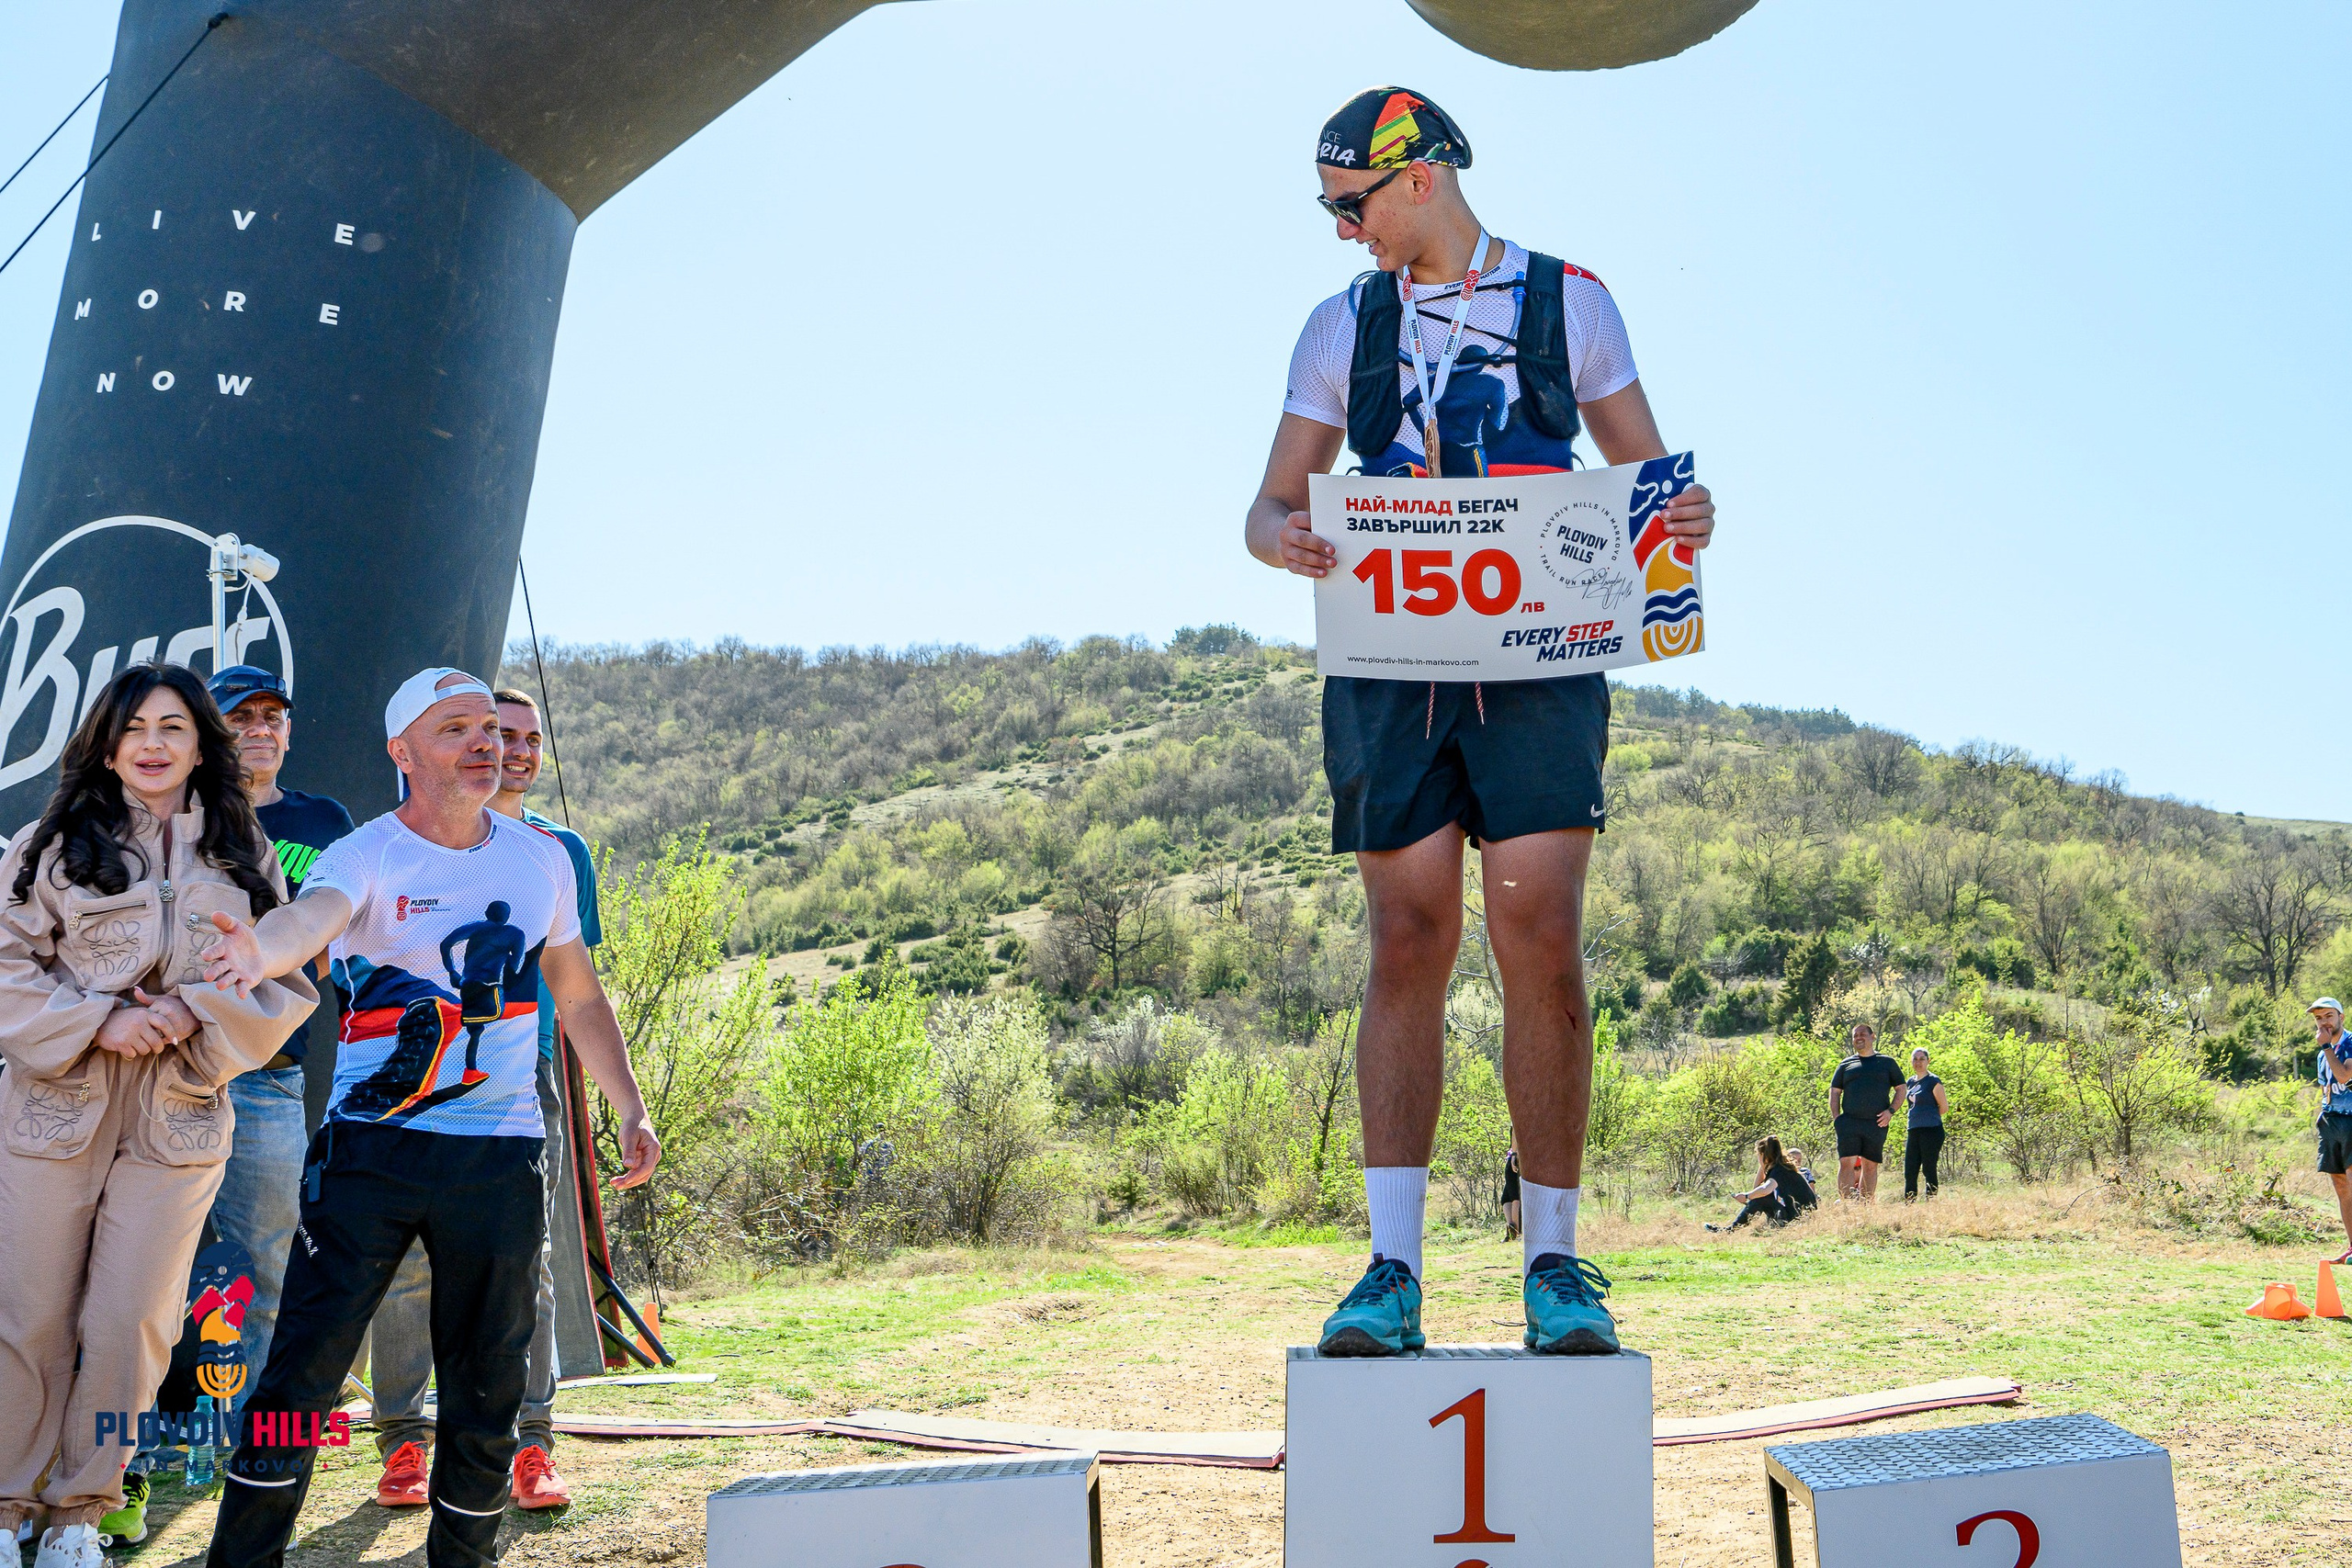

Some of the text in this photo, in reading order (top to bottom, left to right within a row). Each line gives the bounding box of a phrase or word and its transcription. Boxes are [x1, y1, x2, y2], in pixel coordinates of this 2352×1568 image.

[91, 209, 356, 246] LIVE
[74, 288, 341, 326] MORE
[96, 371, 253, 397] NOW
[1346, 495, 1519, 516] НАЙ-МЛАД БЕГАЧ
[1346, 517, 1462, 534] ЗАВЪРШИЛ
[1540, 502, 1621, 561] PLOVDIV HILLS IN MARKOVO
[1556, 525, 1609, 551] PLOVDIV
[1559, 543, 1594, 564] HILLS
[1351, 547, 1522, 616] 150
[1540, 554, 1606, 586] TRAIL RUN RACE
[1501, 620, 1614, 649] EVERY STEP
[1346, 654, 1480, 667] www.plovdiv-hills-in-markovo.com
[1536, 636, 1624, 663] MATTERS
[410, 897, 440, 907] PLOVDIV
[1429, 1387, 1516, 1544] 1
